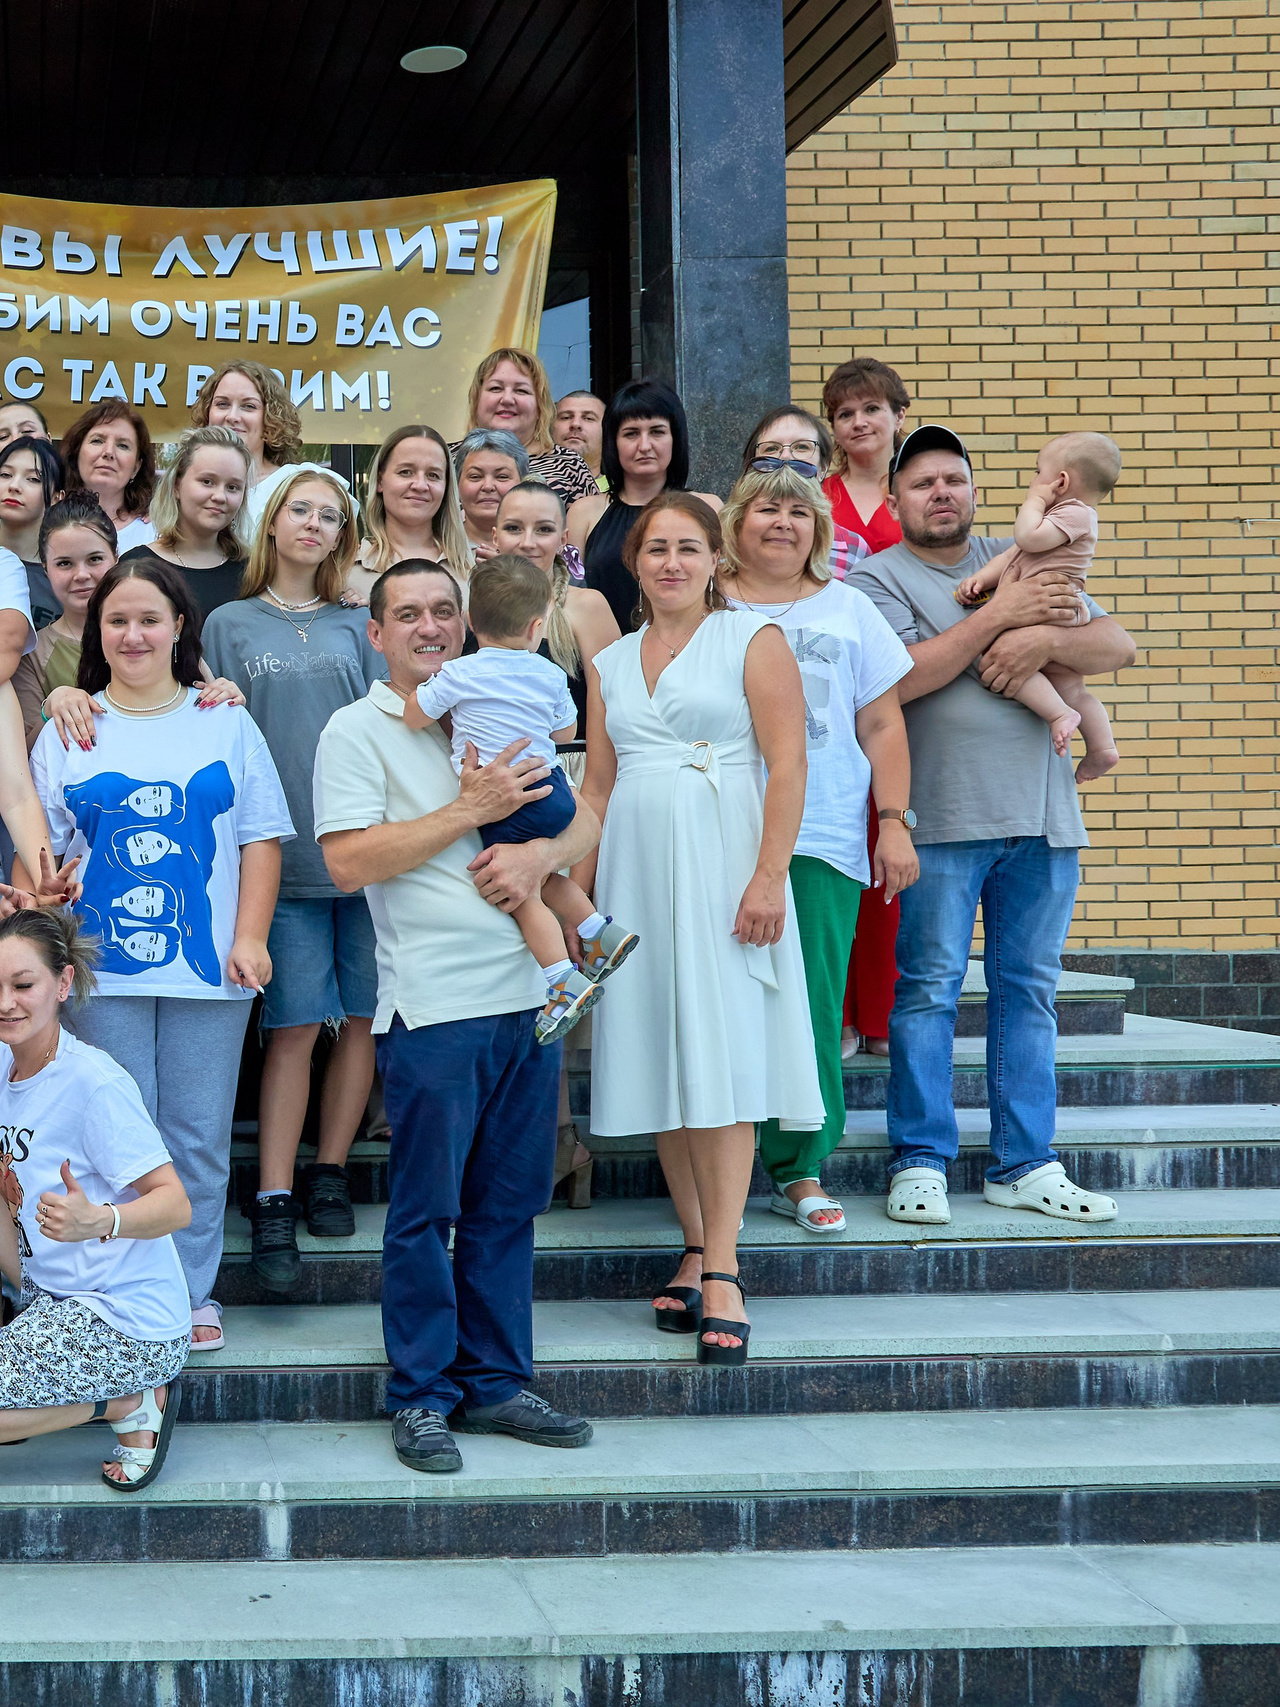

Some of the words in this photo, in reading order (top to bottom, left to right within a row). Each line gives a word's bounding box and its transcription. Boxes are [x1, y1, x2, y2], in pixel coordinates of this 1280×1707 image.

[0, 224, 122, 276] ВЫ
[151, 215, 504, 279] ЛУЧШИЕ!
[129, 299, 319, 346] ОЧЕНЬ
[334, 303, 443, 350] ВАС
[62, 358, 169, 407] ТАК
[244, 652, 282, 682] Life
[286, 651, 360, 674] Nature
